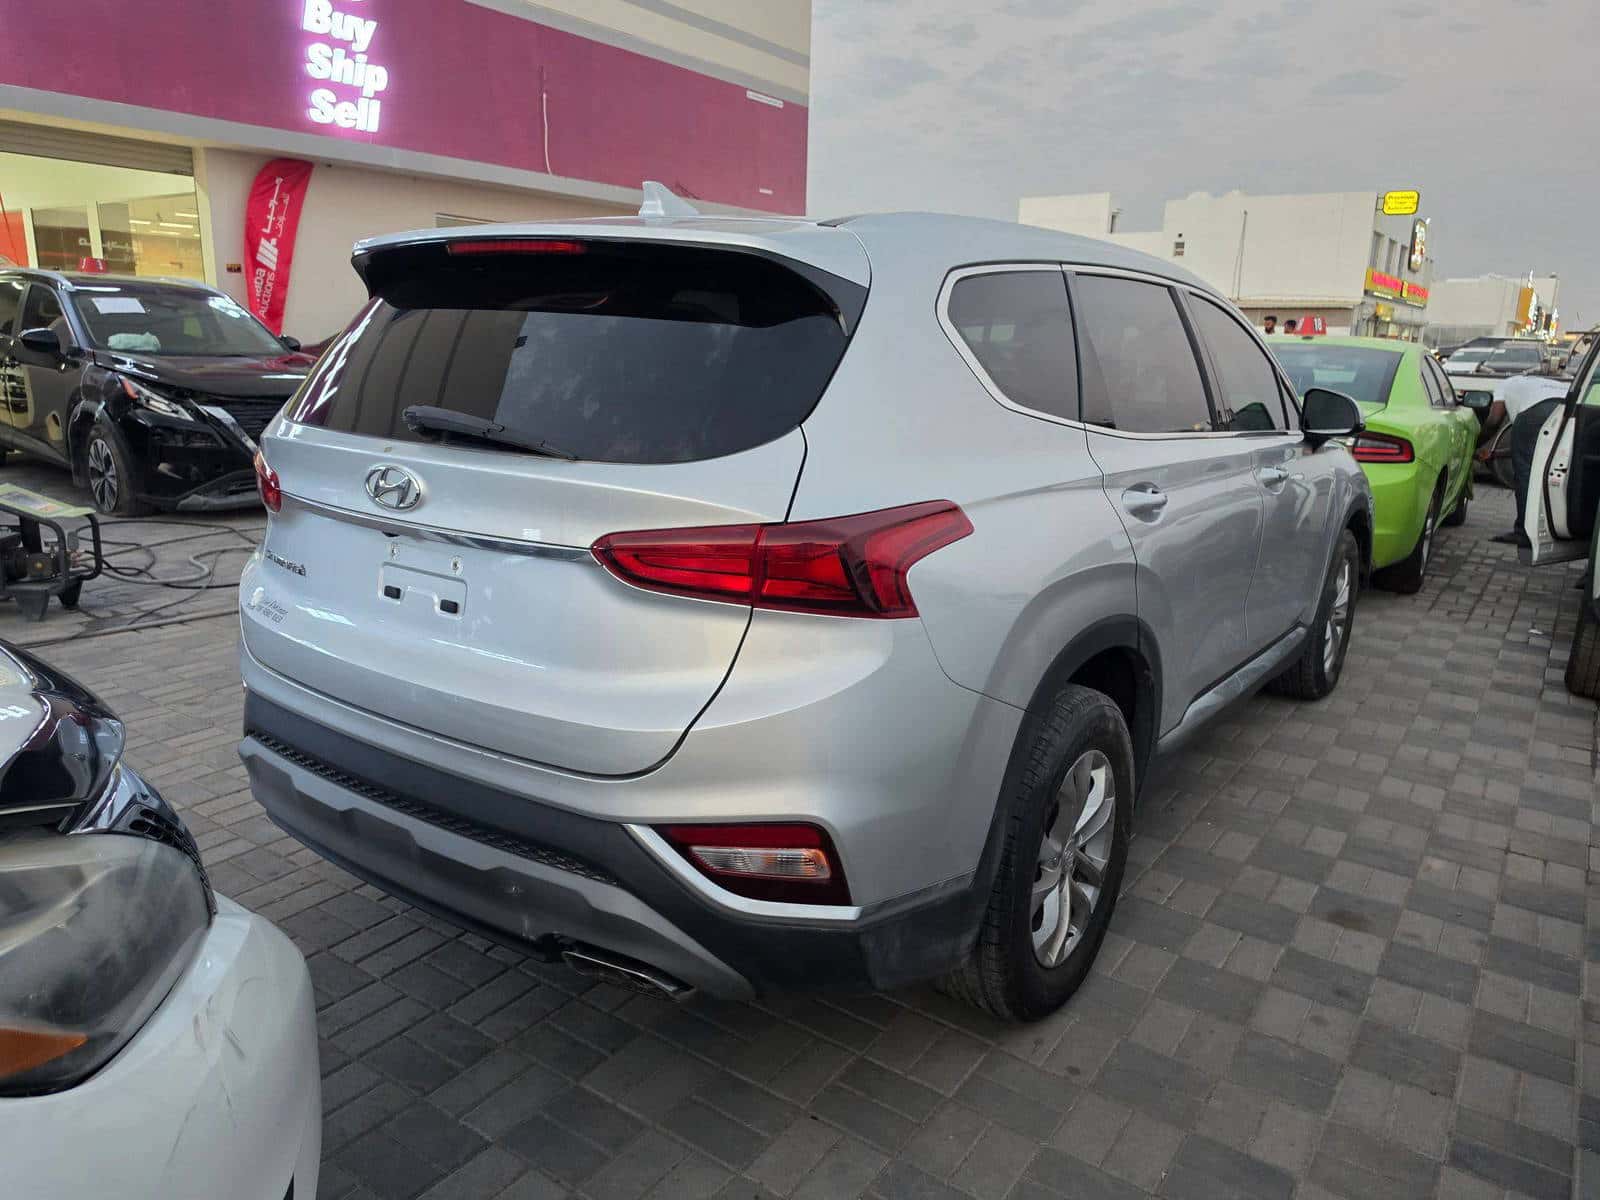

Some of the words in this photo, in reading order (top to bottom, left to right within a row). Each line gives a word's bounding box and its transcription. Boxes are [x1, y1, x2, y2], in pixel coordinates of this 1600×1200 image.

[303, 0, 378, 52] Buy
[305, 42, 389, 97] Ship
[308, 88, 381, 133] Sell
[259, 271, 275, 319] Auctions
